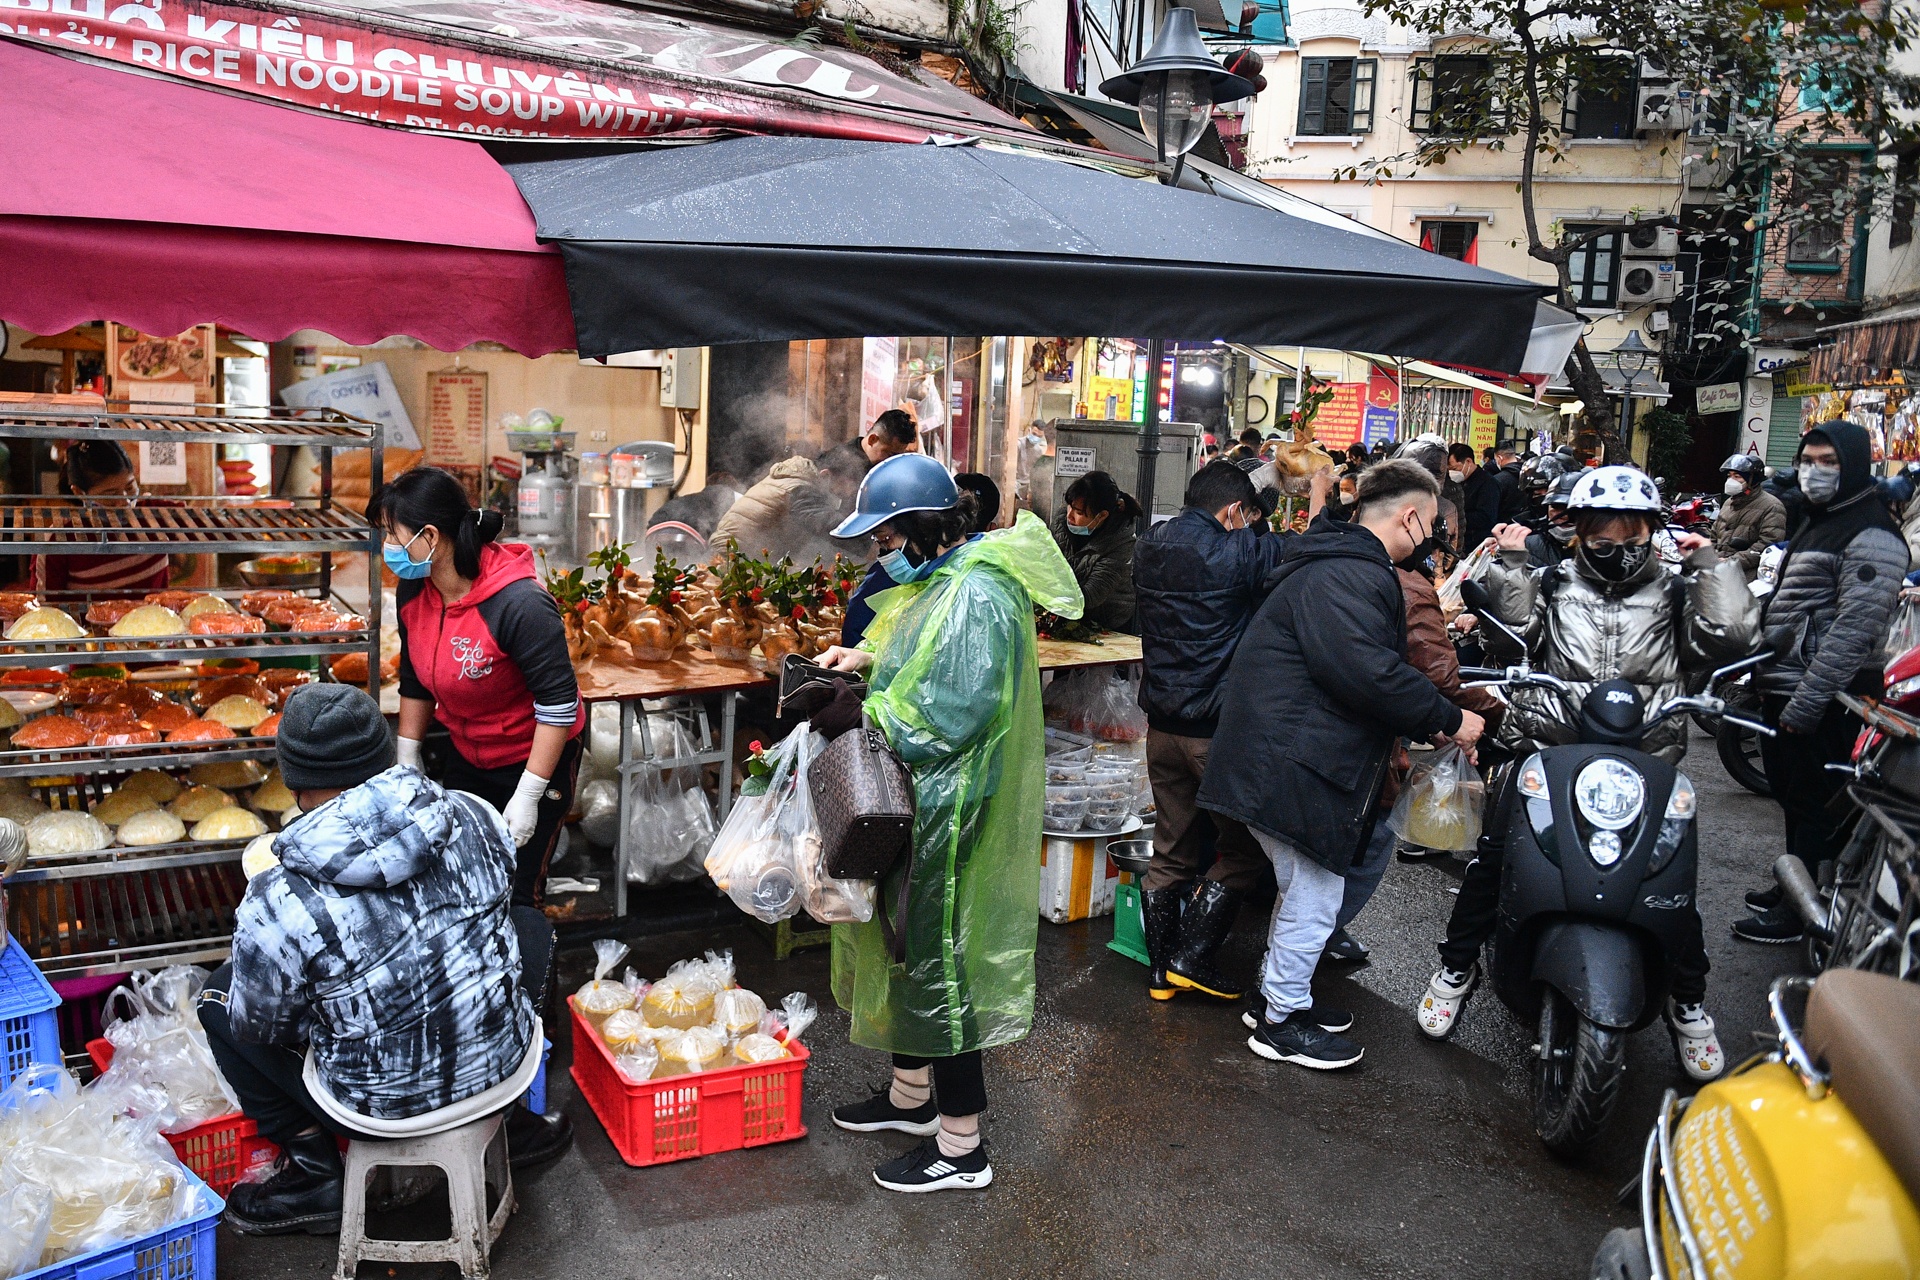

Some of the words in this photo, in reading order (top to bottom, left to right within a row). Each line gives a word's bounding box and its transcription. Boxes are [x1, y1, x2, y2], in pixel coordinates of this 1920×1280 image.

[132, 39, 241, 82] RICE
[255, 53, 442, 107] NOODLE
[453, 84, 564, 122] SOUP
[575, 99, 674, 134] WITH
[373, 48, 638, 104] CHUYÊN
[1605, 690, 1635, 704] SYM
